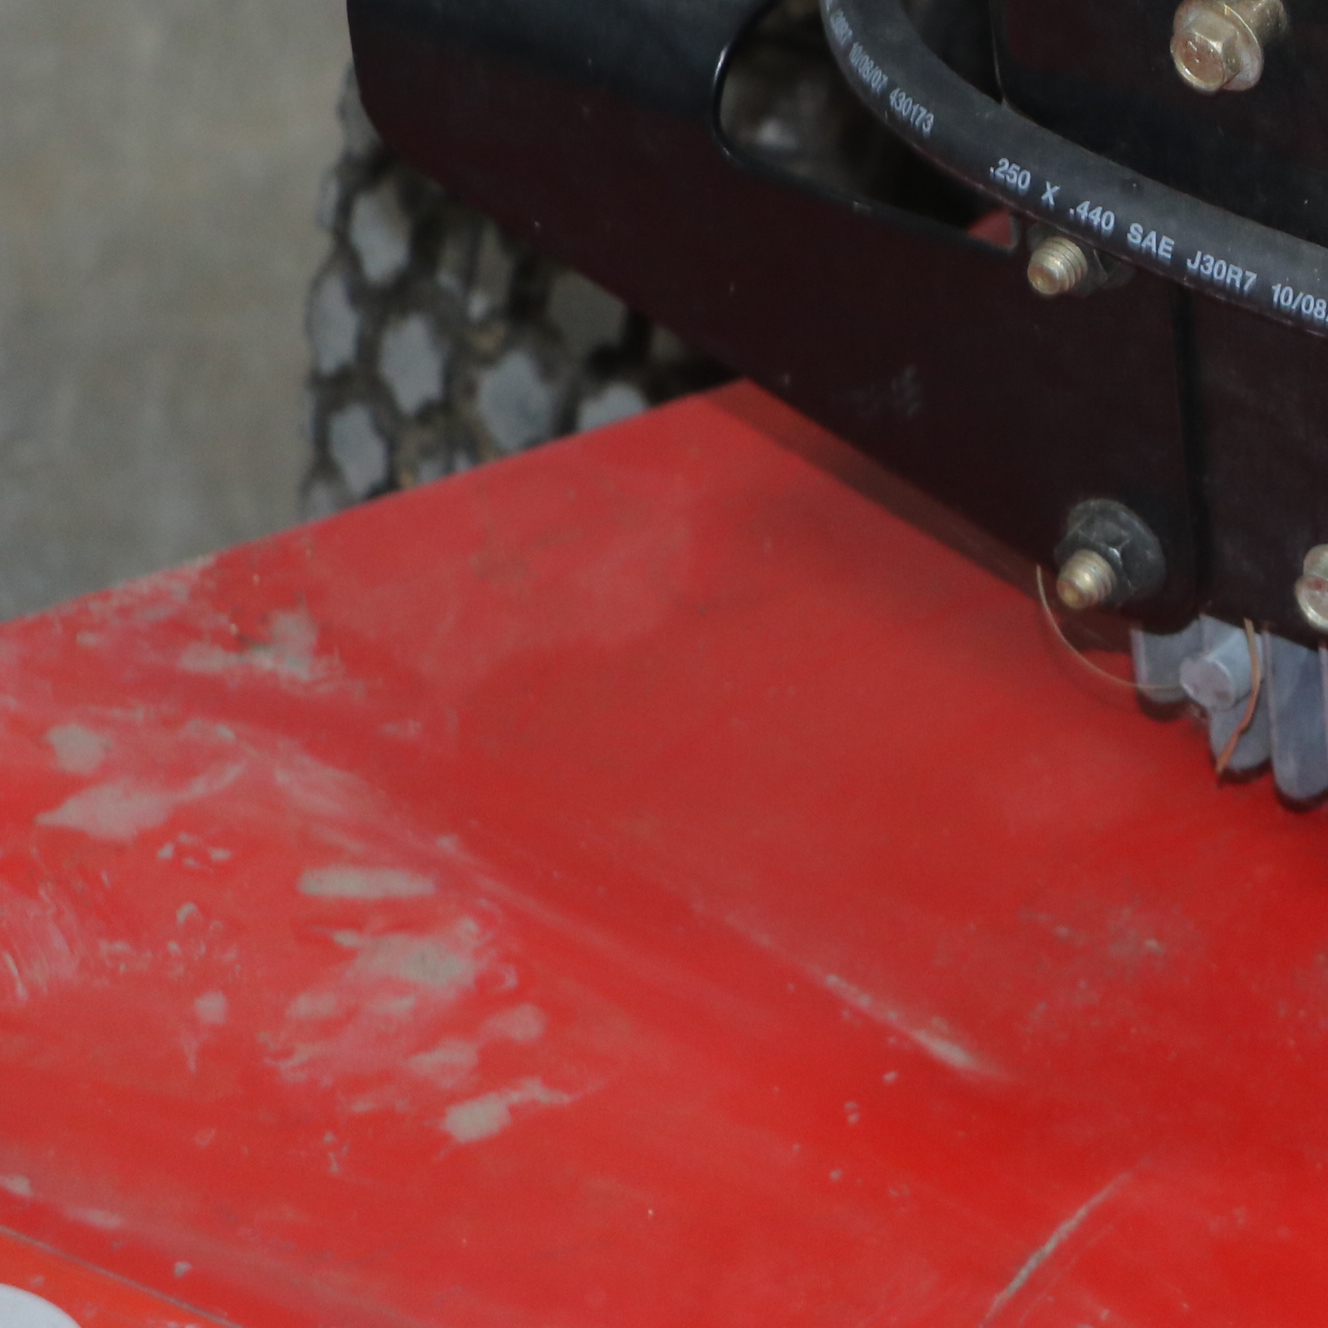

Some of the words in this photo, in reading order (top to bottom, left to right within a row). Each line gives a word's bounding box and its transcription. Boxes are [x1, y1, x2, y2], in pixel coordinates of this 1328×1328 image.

[889, 87, 935, 136] 430173
[989, 157, 1031, 191] .250
[1041, 180, 1061, 206] X
[1069, 200, 1115, 233] .440
[1126, 222, 1175, 260] SAE
[1186, 250, 1257, 292] J30R7
